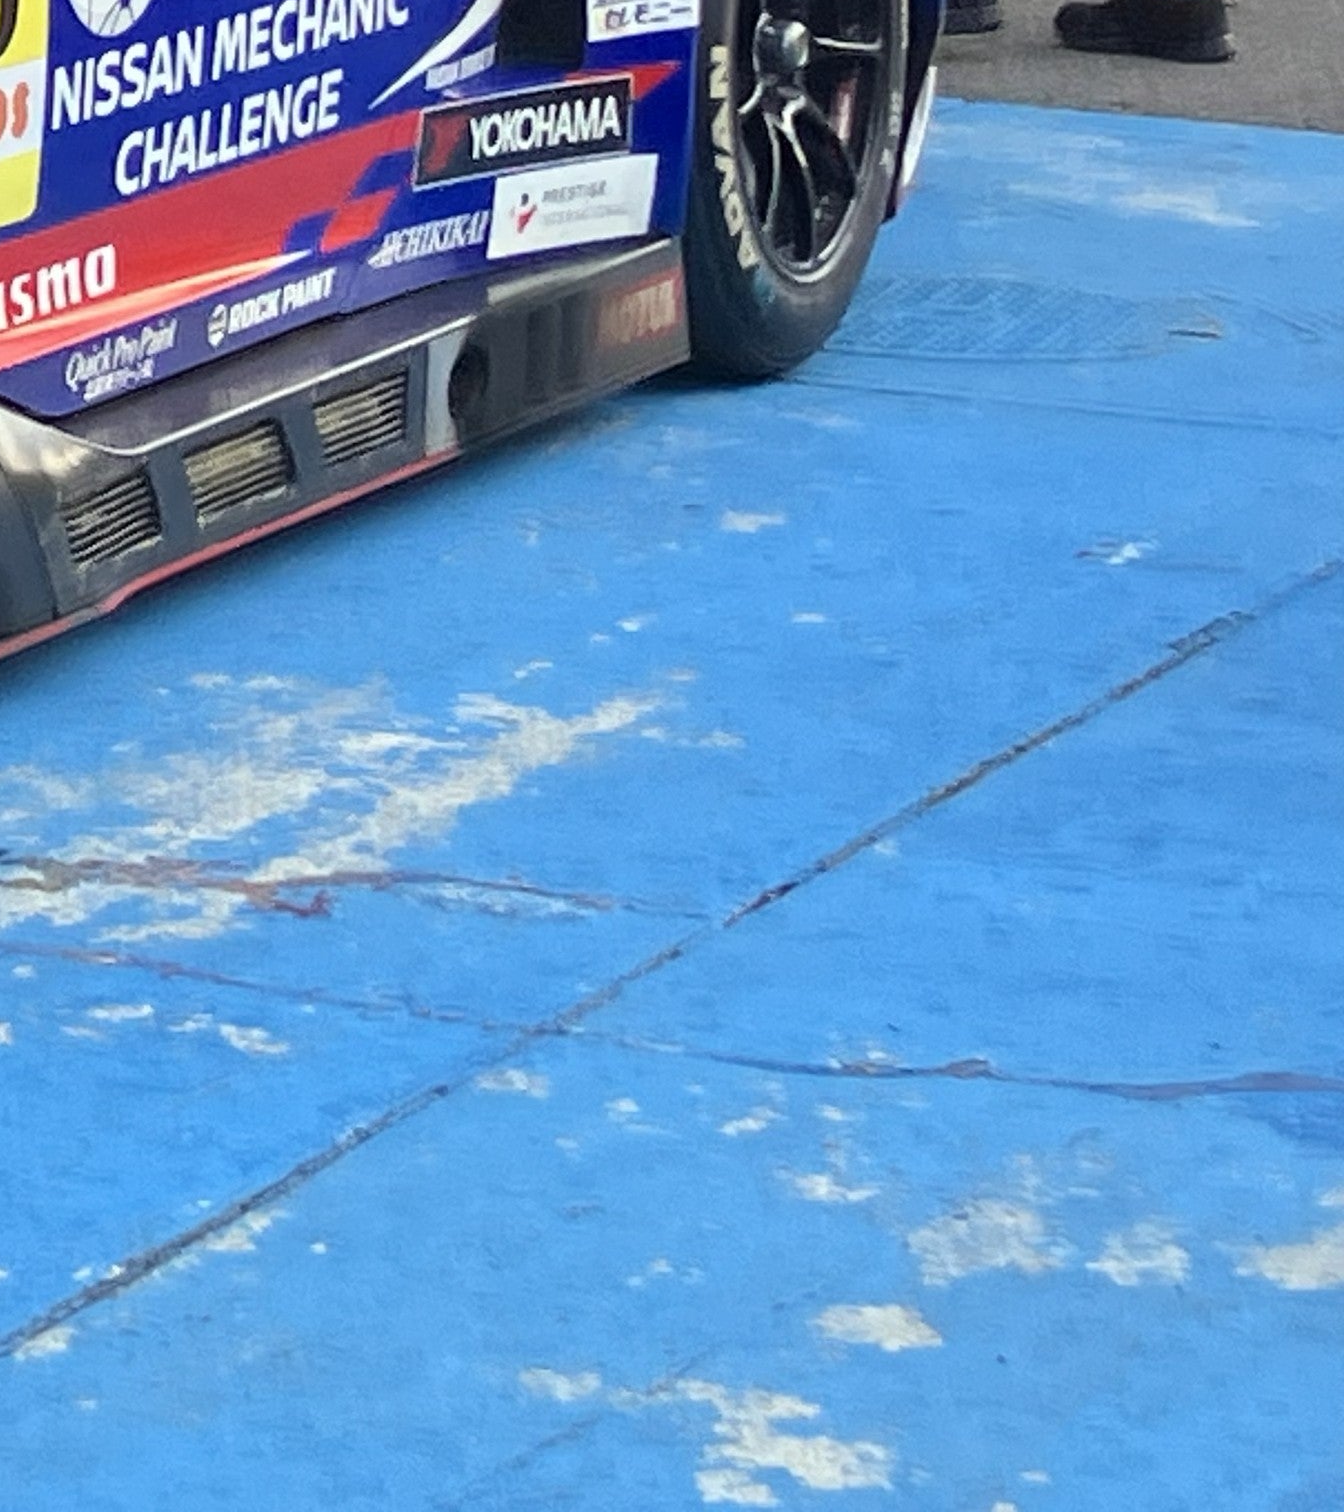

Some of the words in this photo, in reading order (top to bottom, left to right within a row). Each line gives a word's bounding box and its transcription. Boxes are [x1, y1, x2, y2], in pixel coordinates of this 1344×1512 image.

[51, 25, 205, 131] NISSAN
[114, 68, 345, 196] CHALLENGE
[468, 93, 622, 161] YOKOHAMA
[281, 267, 338, 314] PAINT
